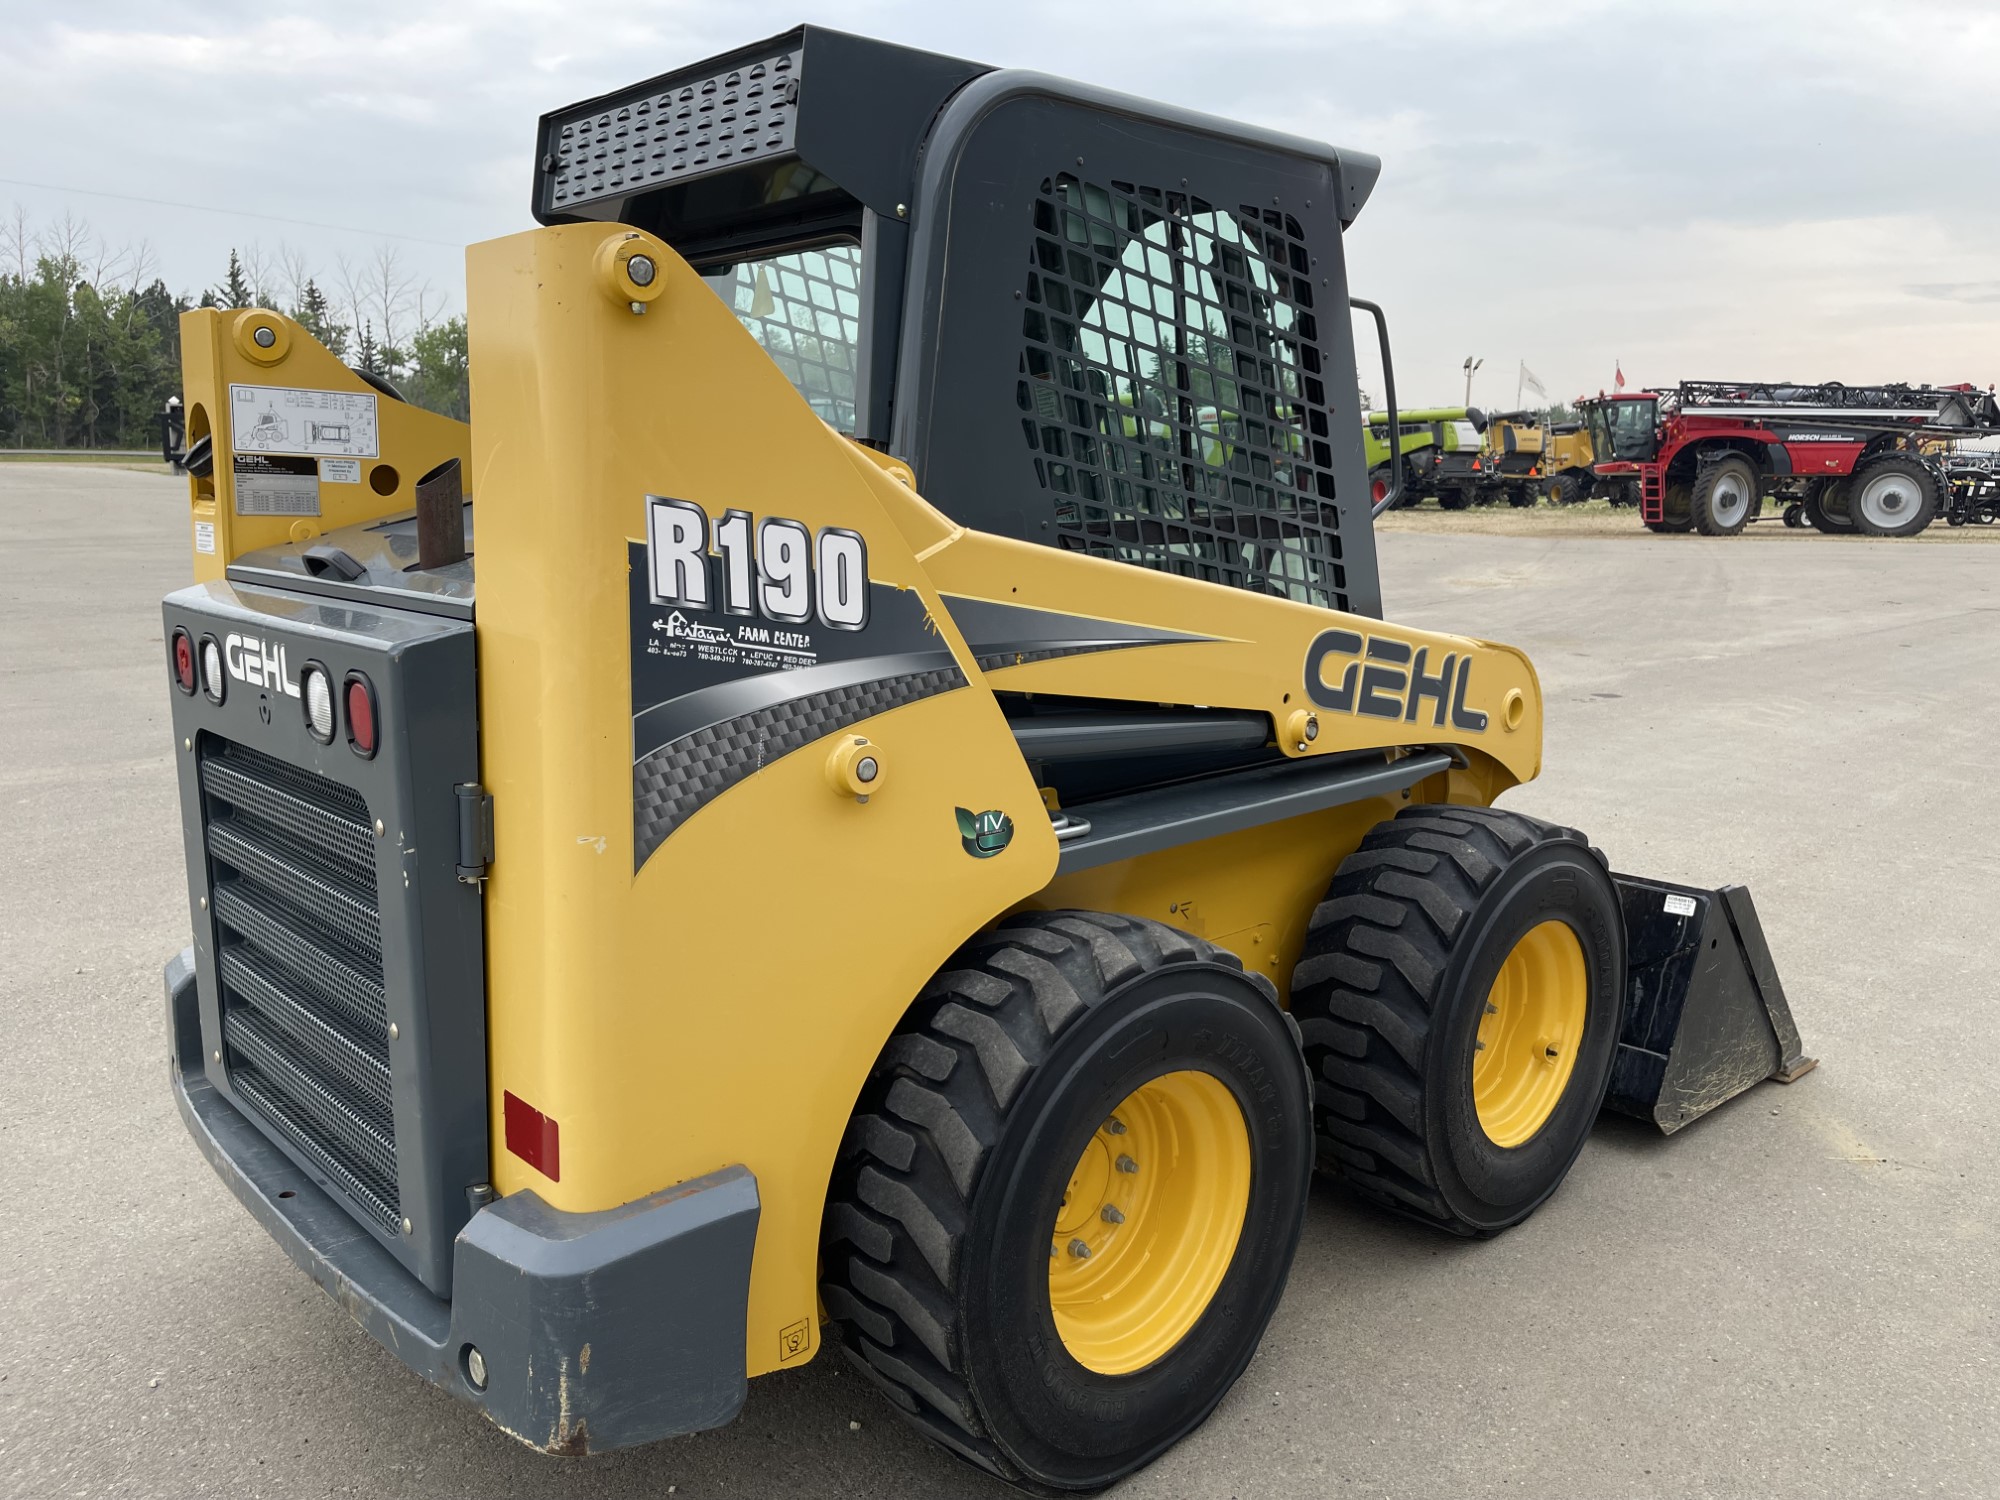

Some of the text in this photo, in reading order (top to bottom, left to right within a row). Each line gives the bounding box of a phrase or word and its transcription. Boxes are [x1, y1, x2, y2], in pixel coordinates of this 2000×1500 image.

[237, 455, 269, 463] GEHL
[644, 493, 871, 632] R190
[738, 625, 770, 643] FARM
[773, 630, 810, 648] CENTER
[225, 632, 300, 698] GEHL
[783, 655, 798, 663] RED
[1303, 627, 1489, 734] GEHL
